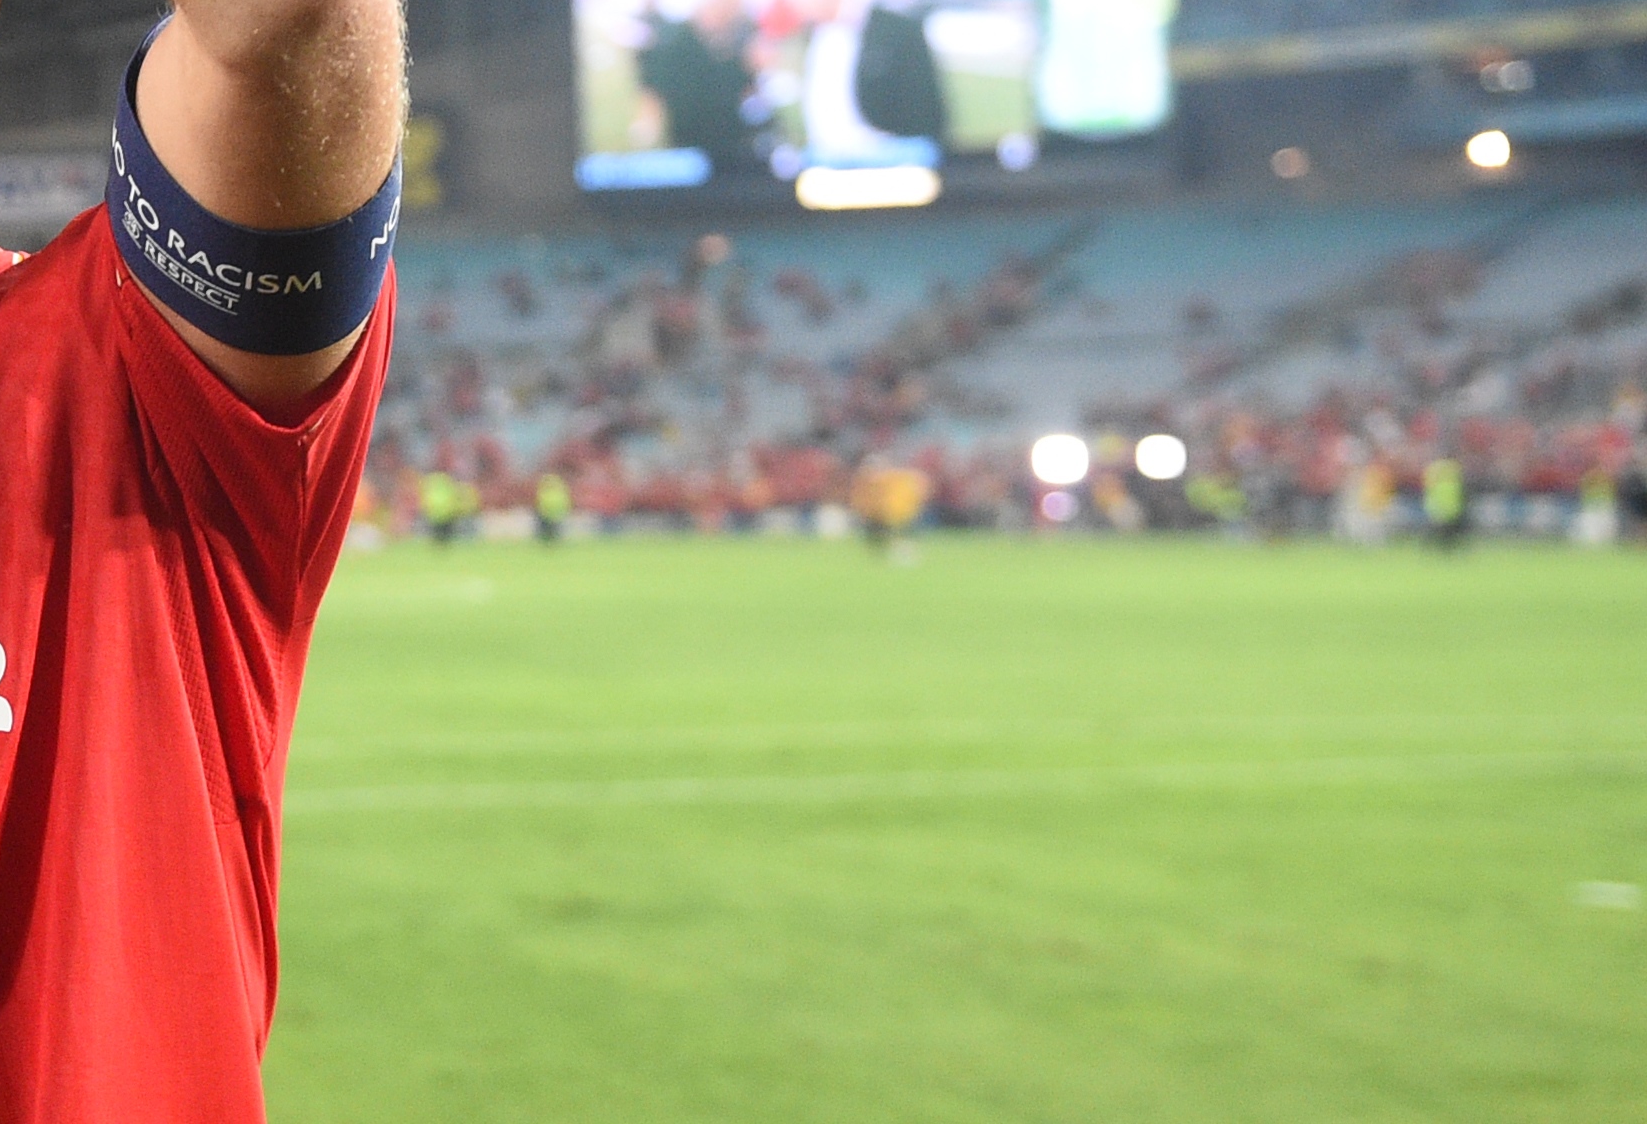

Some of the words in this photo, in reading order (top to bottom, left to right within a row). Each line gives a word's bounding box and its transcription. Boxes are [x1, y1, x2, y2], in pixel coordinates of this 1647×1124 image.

[128, 174, 159, 231] TO
[167, 228, 323, 294] RACISM
[145, 240, 239, 309] RESPECT
